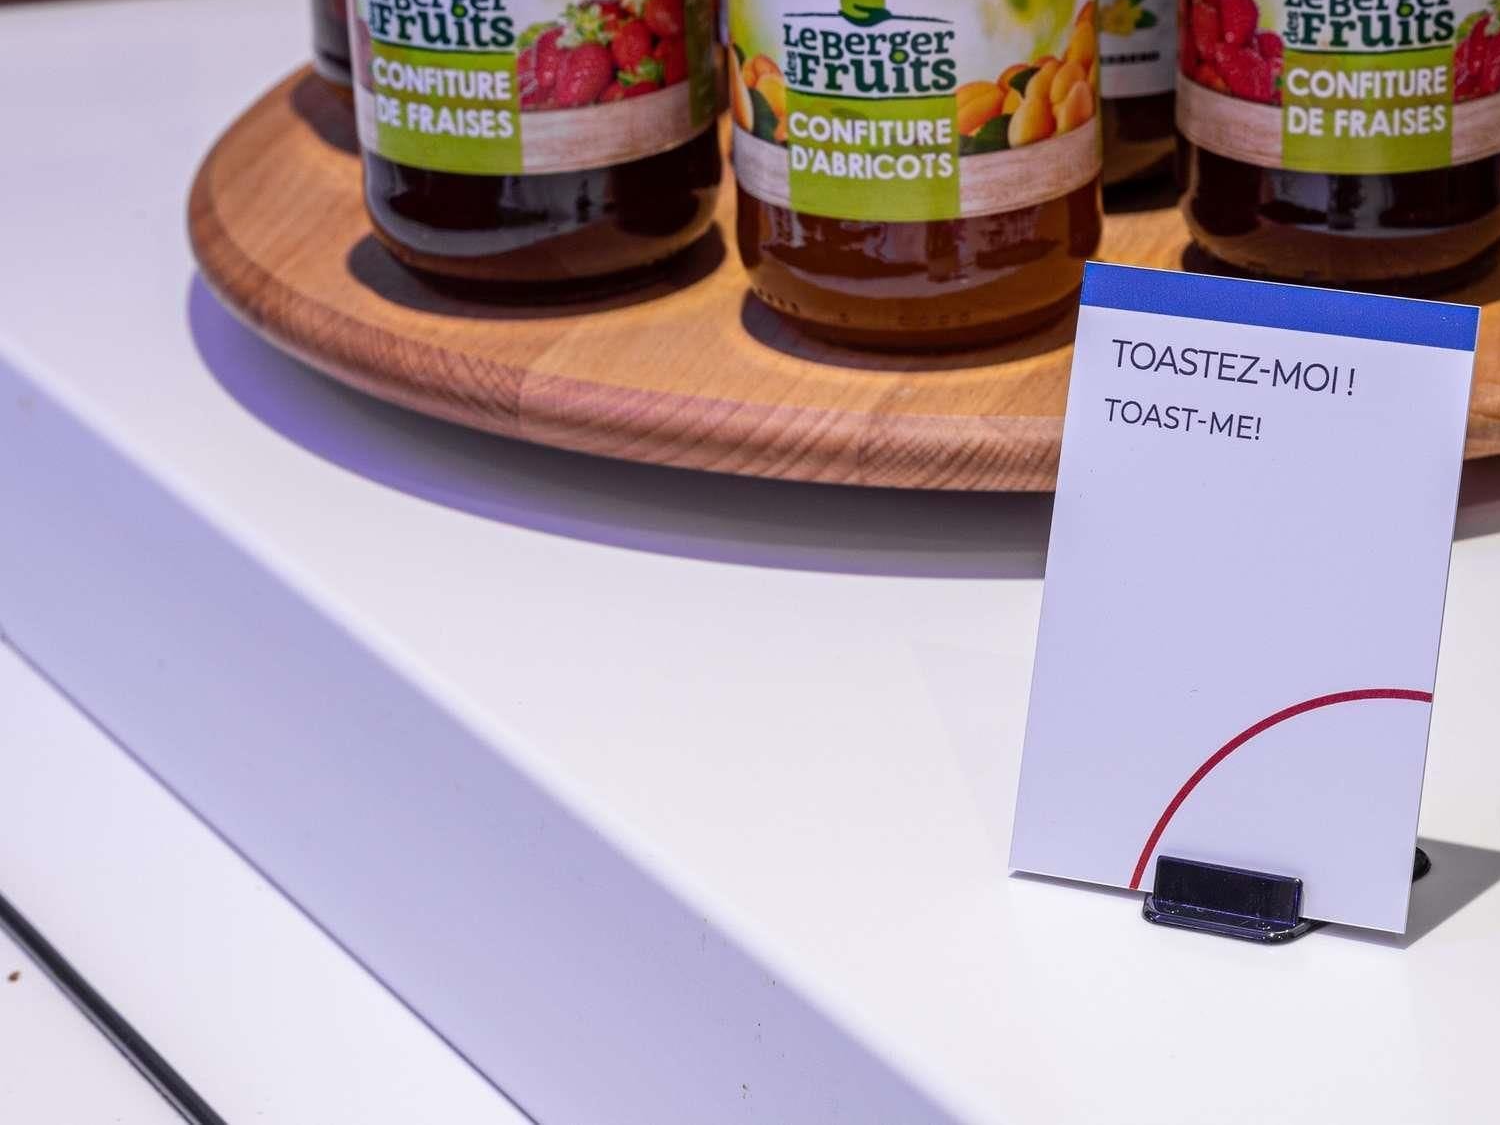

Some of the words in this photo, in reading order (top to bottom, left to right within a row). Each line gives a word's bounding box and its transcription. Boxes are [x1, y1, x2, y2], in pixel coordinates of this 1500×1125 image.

[376, 2, 515, 47] Fruits
[783, 24, 818, 50] Le
[821, 28, 955, 64] Berger
[1301, 11, 1455, 47] Fruits
[372, 57, 511, 100] CONFITURE
[800, 52, 957, 94] Fruits
[1287, 66, 1447, 99] CONFITURE
[375, 94, 402, 128] DE
[407, 102, 514, 138] FRAISES
[788, 112, 952, 145] CONFITURE
[1288, 106, 1324, 136] DE
[1334, 105, 1446, 138] FRAISES
[791, 146, 953, 179] D'ABRICOTS
[1104, 397, 1262, 441] TOAST-ME!
